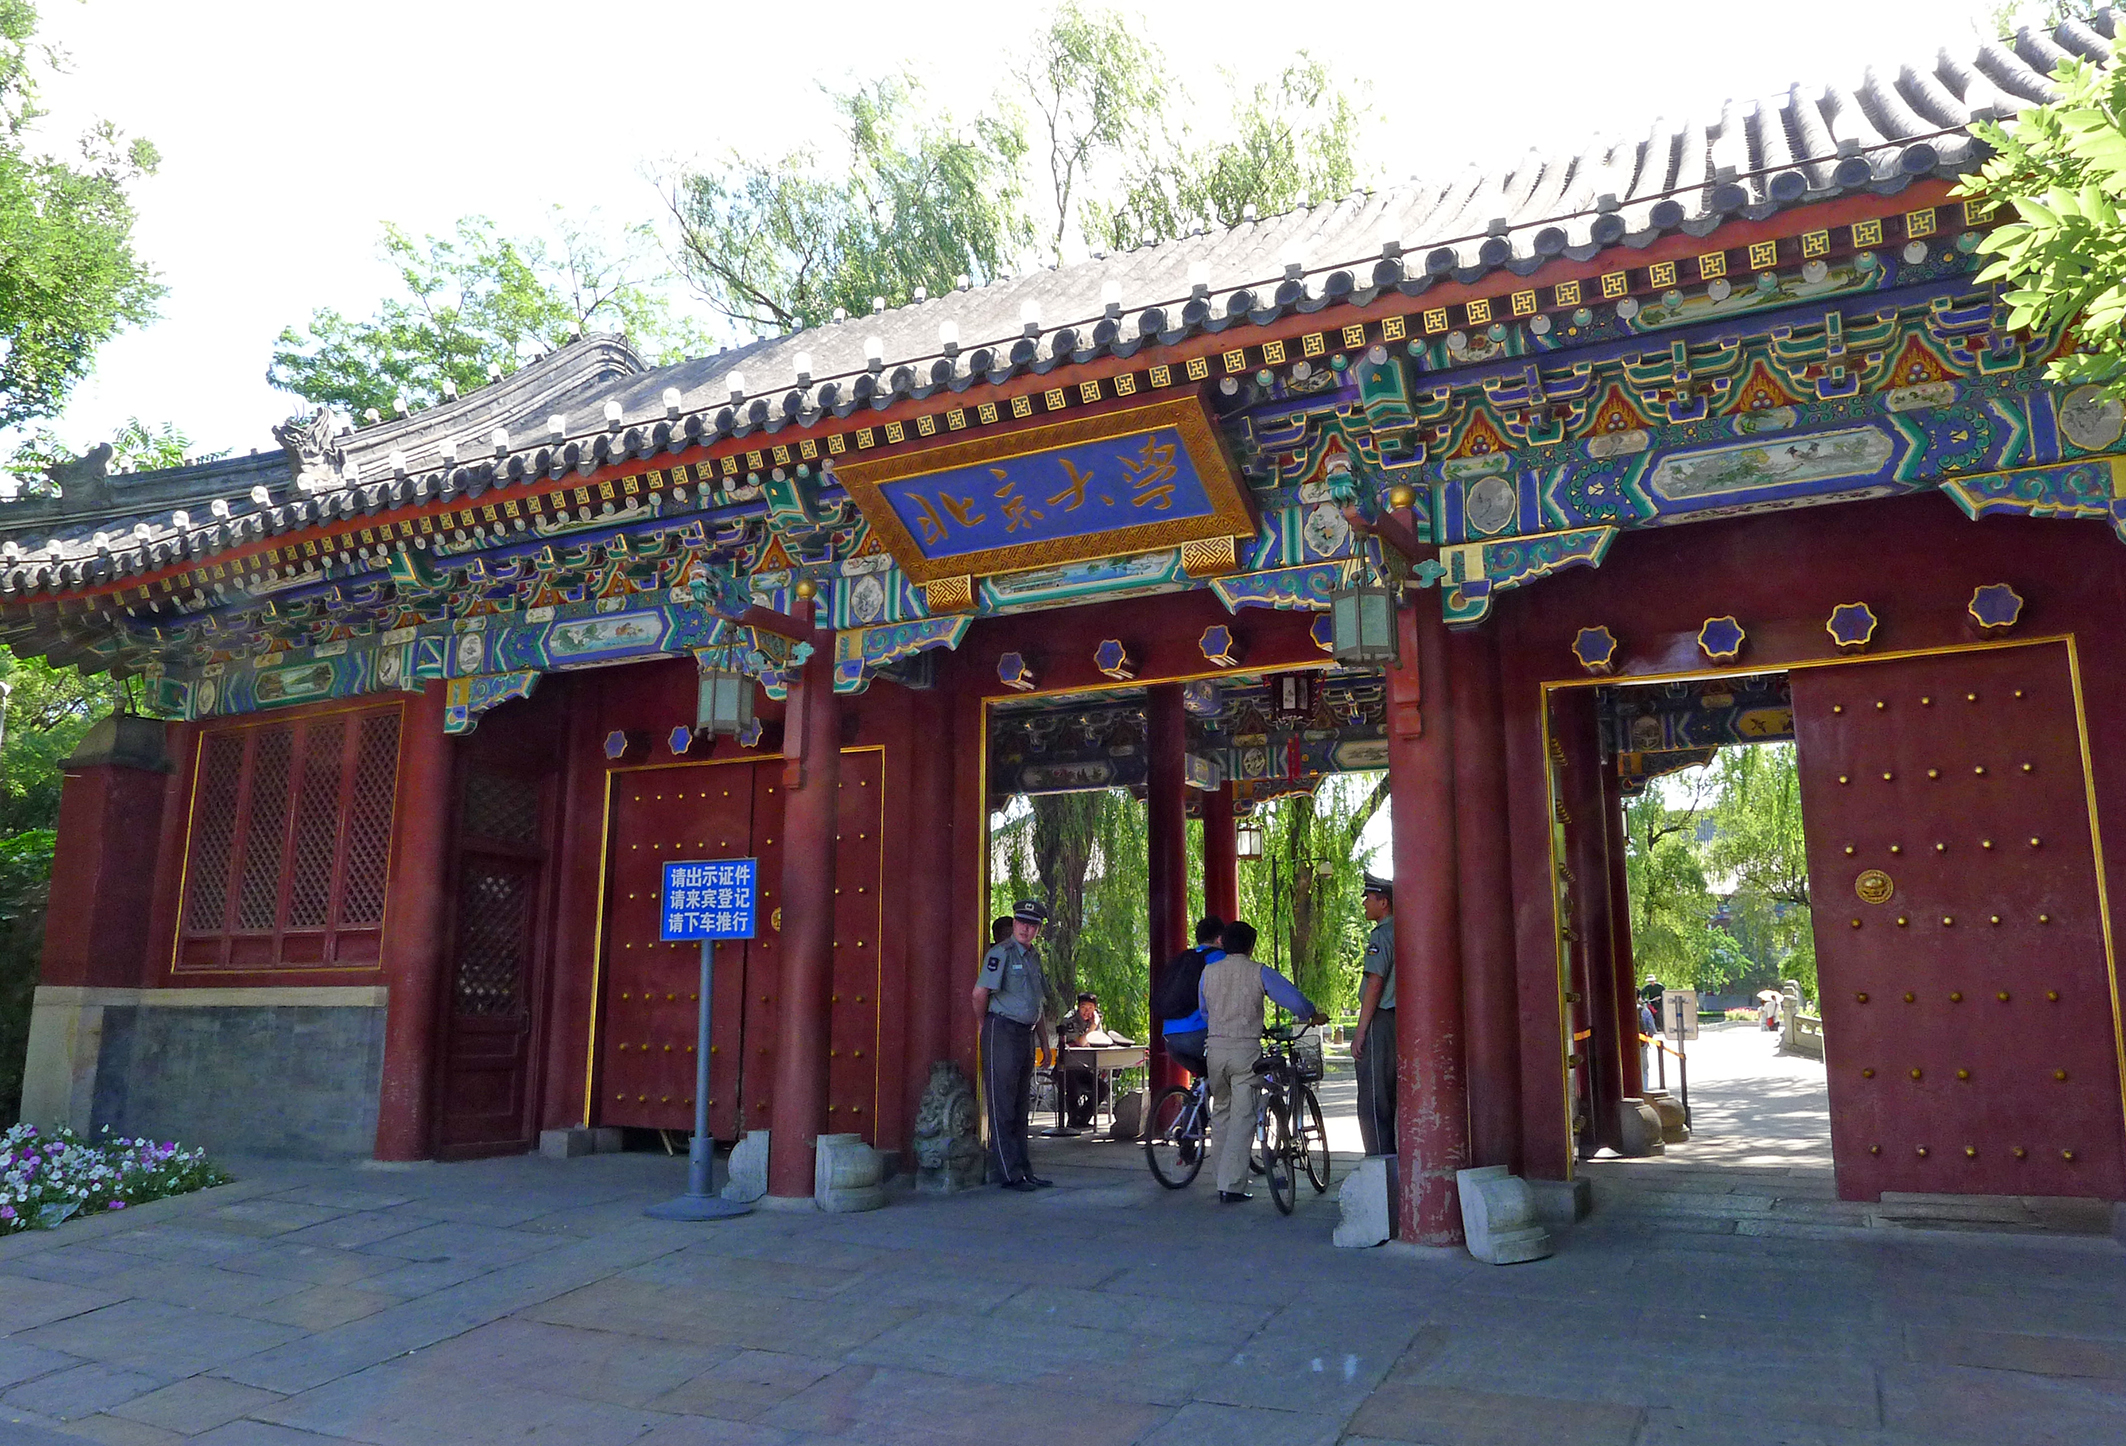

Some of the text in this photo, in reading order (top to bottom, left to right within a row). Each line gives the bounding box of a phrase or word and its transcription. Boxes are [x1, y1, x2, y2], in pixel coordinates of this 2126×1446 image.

[671, 864, 751, 888] 请出示证件
[669, 887, 750, 910] 请来宾登记
[668, 911, 749, 933] 请下车推行
